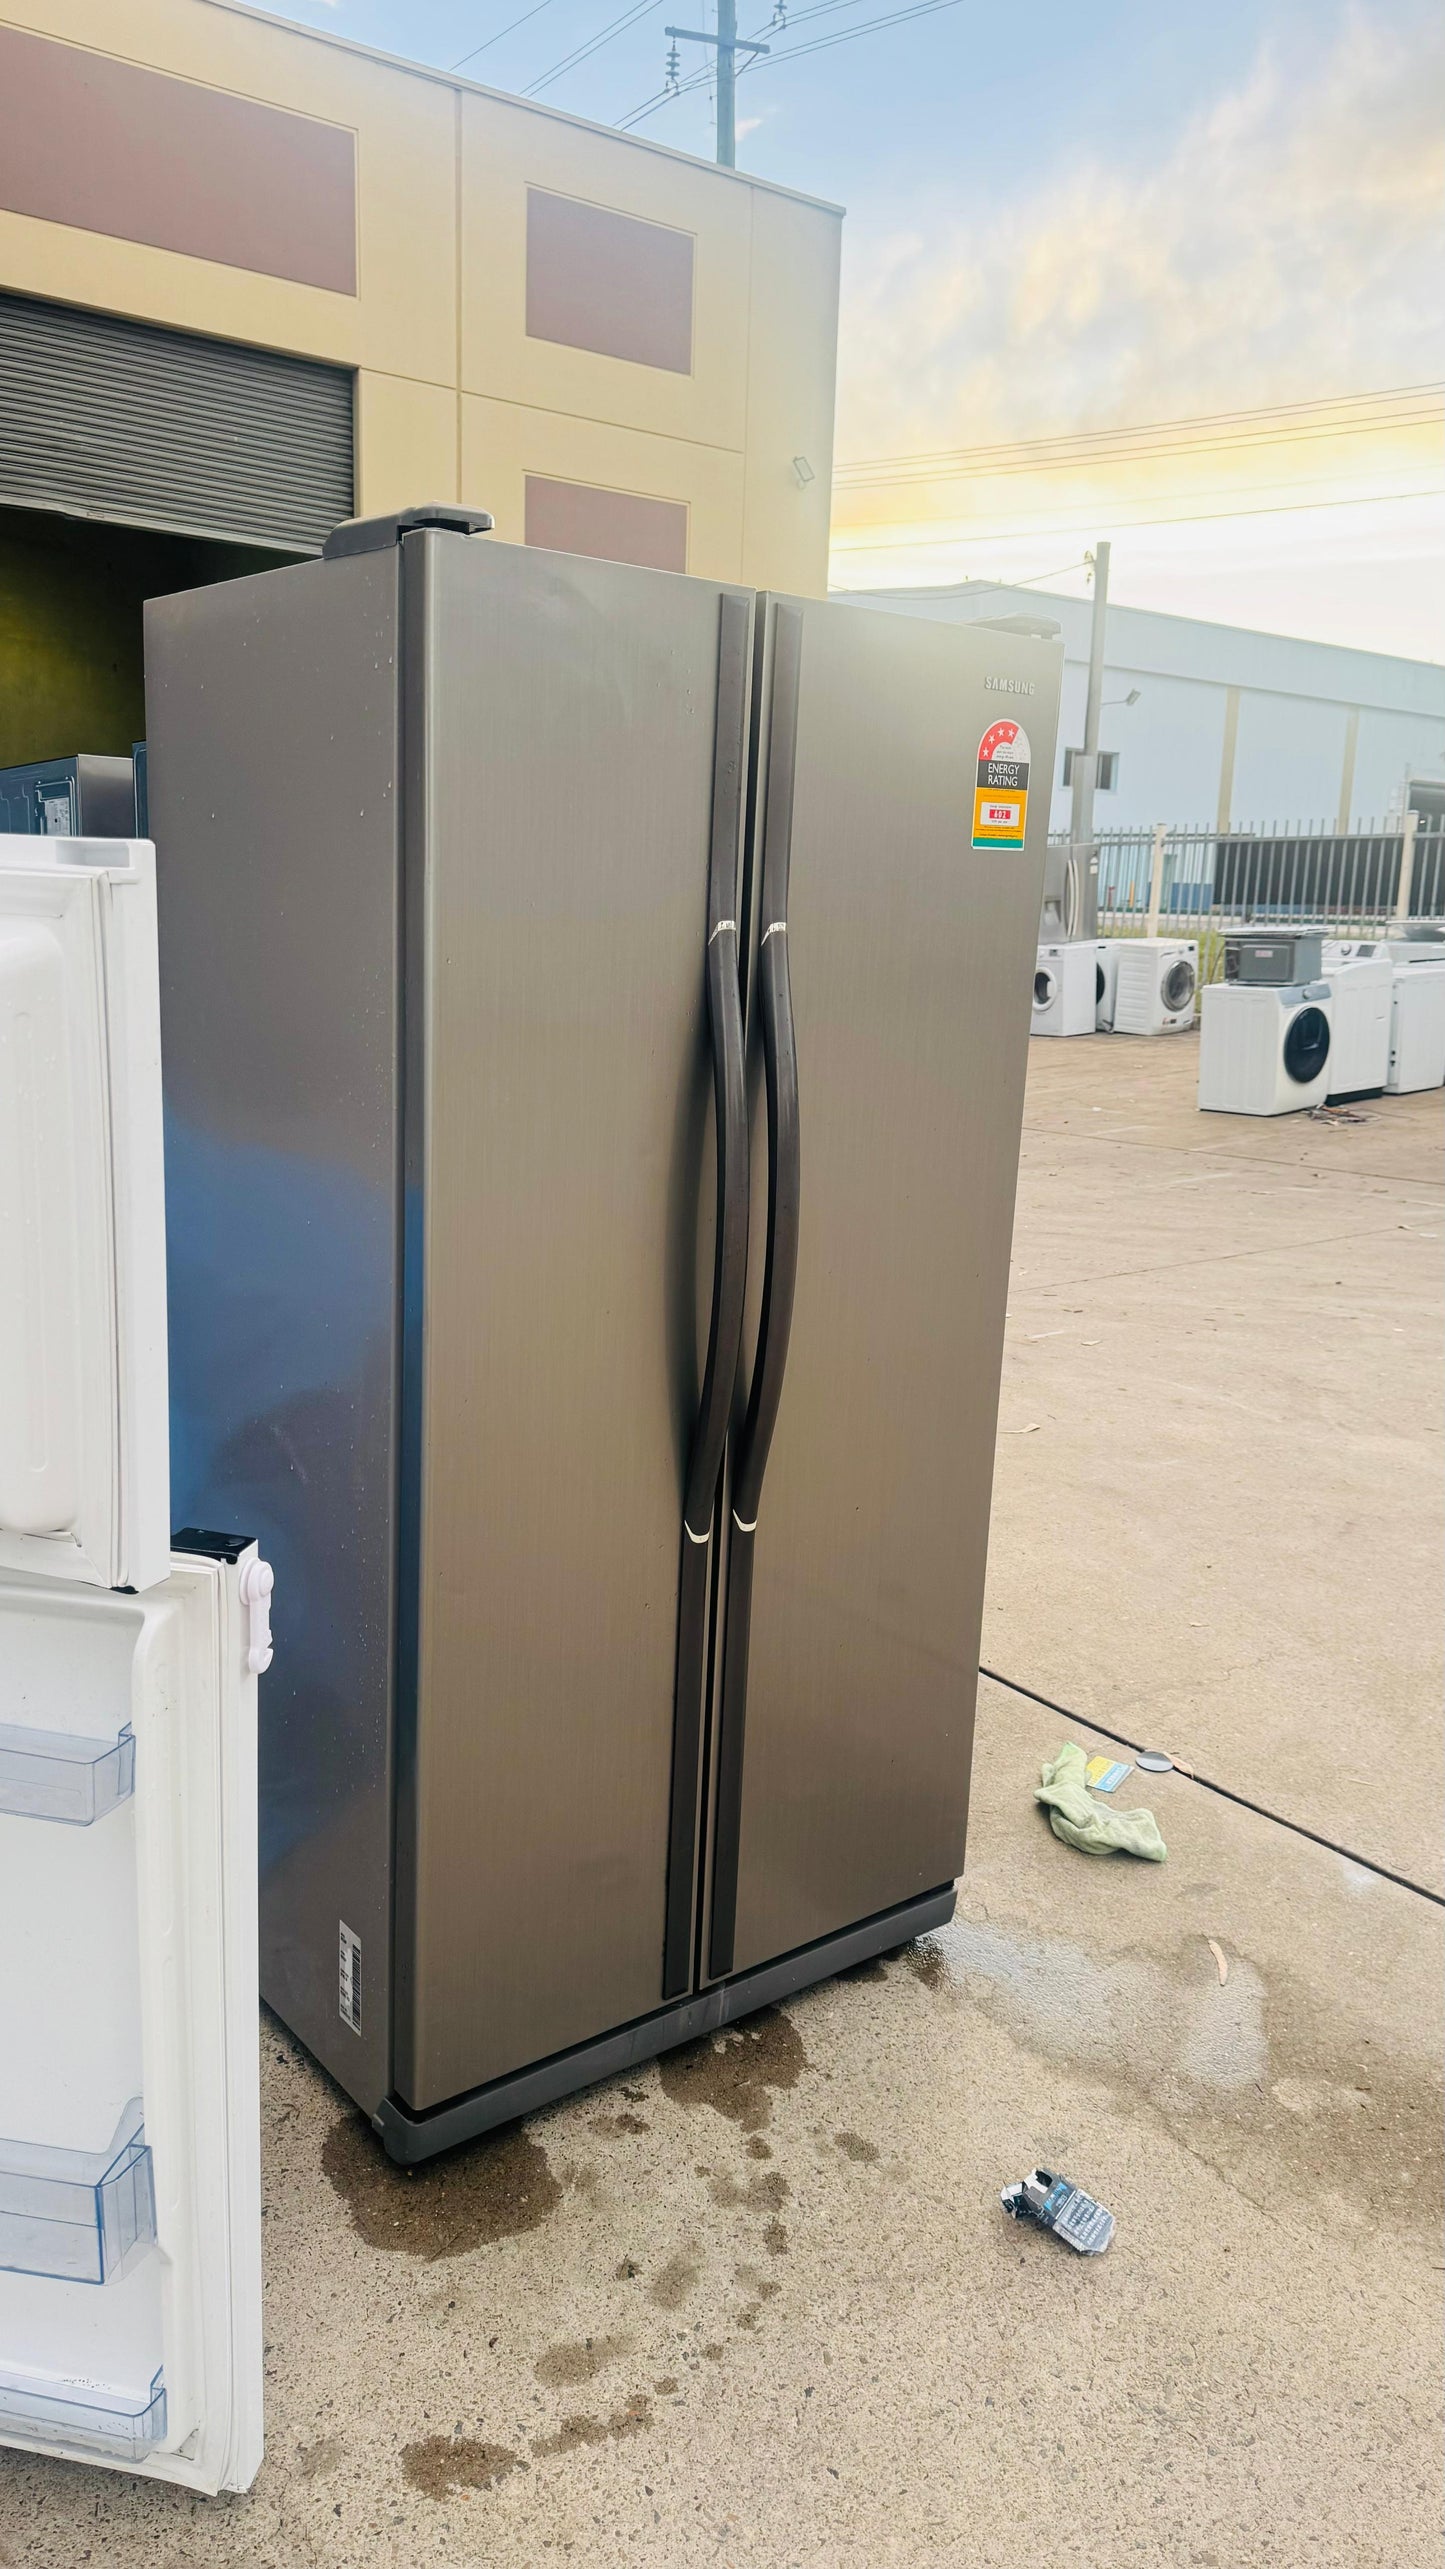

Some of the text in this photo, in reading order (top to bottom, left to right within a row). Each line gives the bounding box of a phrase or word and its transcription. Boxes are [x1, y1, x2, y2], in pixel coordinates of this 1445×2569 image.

[985, 676, 1035, 695] SAMSUNG
[987, 762, 1020, 775] ENERGY
[987, 774, 1018, 787] RATING
